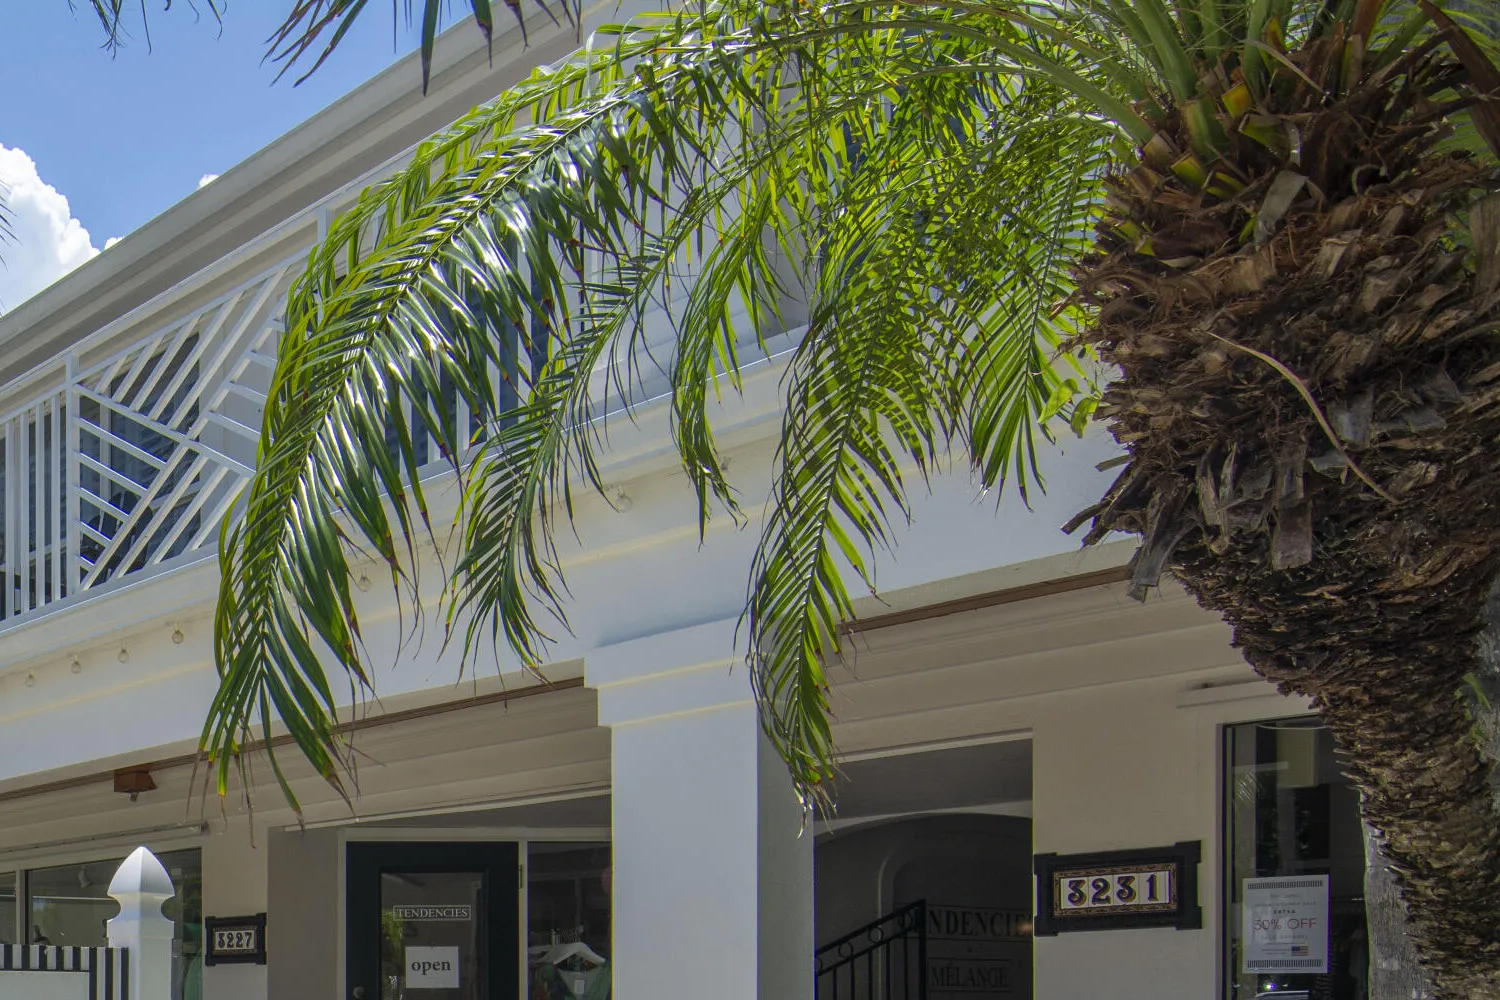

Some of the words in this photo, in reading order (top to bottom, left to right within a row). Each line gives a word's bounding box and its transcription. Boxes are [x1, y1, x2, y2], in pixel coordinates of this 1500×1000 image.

[1067, 873, 1160, 907] 3231
[396, 908, 468, 918] TENDENCIES
[914, 908, 1032, 937] NDENCIE
[1287, 917, 1317, 930] OFF
[218, 931, 253, 949] 3227
[411, 960, 452, 976] open
